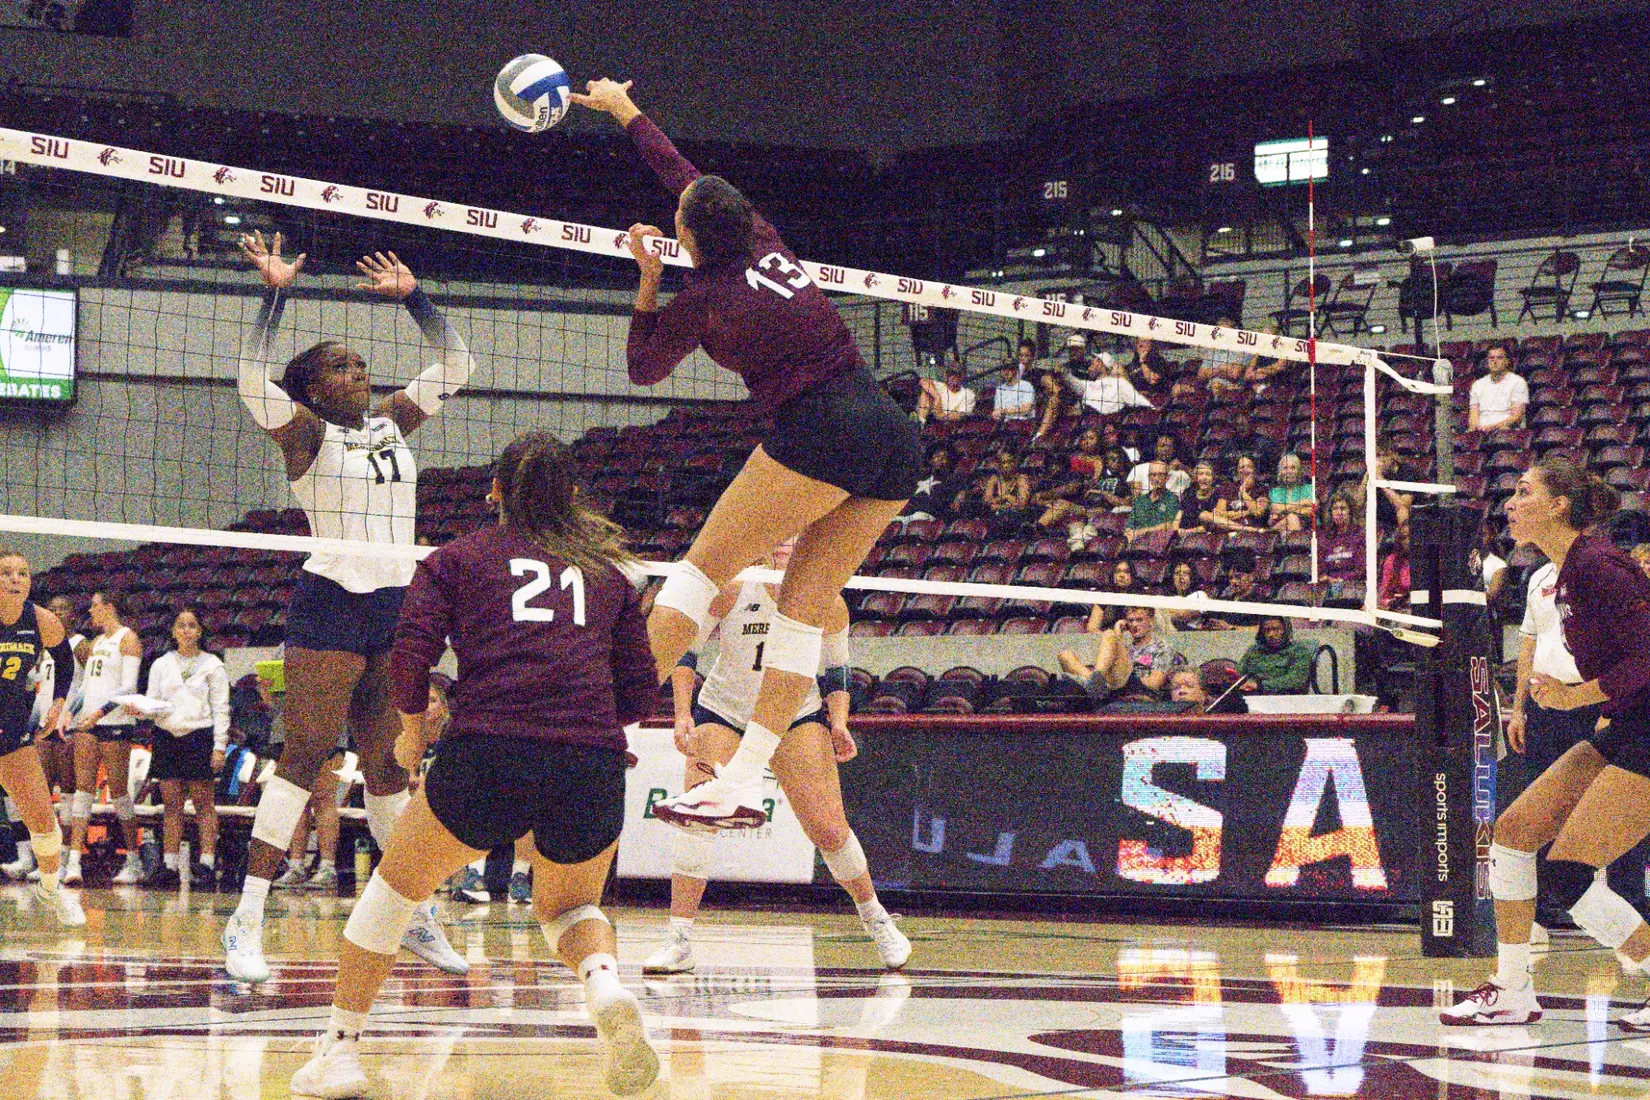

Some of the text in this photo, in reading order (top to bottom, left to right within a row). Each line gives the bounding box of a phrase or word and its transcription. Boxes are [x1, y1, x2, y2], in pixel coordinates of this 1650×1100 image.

[31, 136, 69, 159] SIU
[148, 156, 186, 178] SIU
[260, 175, 295, 197] SIU
[366, 192, 399, 213] SIU
[466, 209, 498, 229] SIU
[561, 224, 591, 244] SIU
[651, 239, 680, 258] SIU
[744, 252, 812, 299] 13
[819, 266, 845, 284] SIU
[897, 278, 923, 295] SIU
[971, 290, 995, 307] SIU
[1042, 302, 1065, 318] SIU
[1111, 312, 1132, 328] SIU
[1175, 321, 1196, 337] SIU
[1237, 331, 1257, 346] SIU
[1295, 340, 1309, 354] SI
[367, 450, 401, 484] 17
[509, 558, 586, 627] 21
[752, 641, 766, 671] 1
[0, 656, 22, 680] 2
[1470, 656, 1492, 900] SALUKIS
[1432, 772, 1450, 882] sports imports
